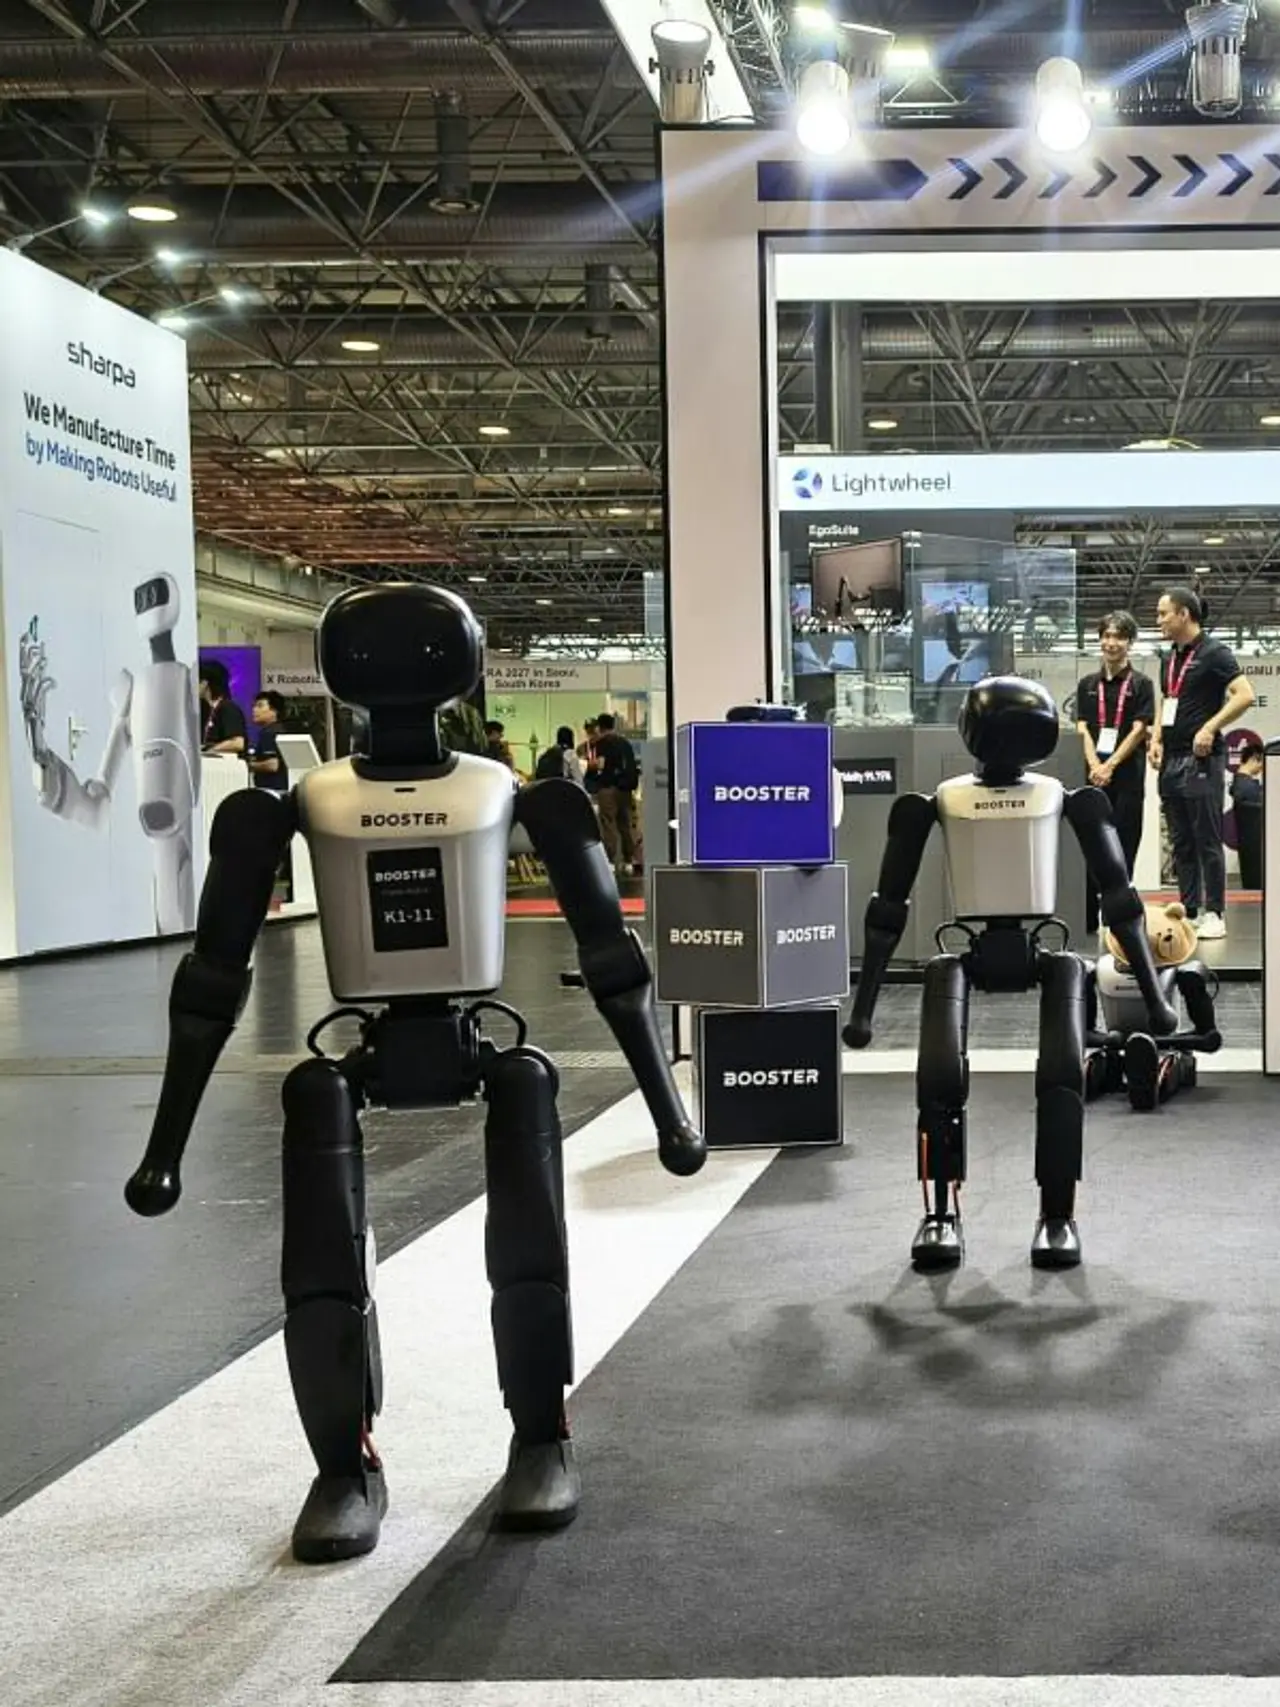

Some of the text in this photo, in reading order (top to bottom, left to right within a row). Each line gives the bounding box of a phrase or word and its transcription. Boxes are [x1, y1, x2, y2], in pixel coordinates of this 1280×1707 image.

[66, 341, 136, 388] sharpa
[23, 391, 176, 471] We Manufacture Time
[25, 431, 177, 502] by Making Robots Useful
[832, 471, 952, 496] Lightwheel
[495, 679, 561, 689] South Korea
[713, 785, 812, 802] BOOSTER
[974, 799, 1025, 811] BOOSTER
[361, 813, 449, 828] BOOSTER
[374, 867, 437, 882] BOOSTER
[384, 908, 434, 924] K1-11
[669, 928, 745, 946] BOOSTER
[776, 924, 836, 945] BOOSTER
[723, 1068, 820, 1087] BOOSTER
